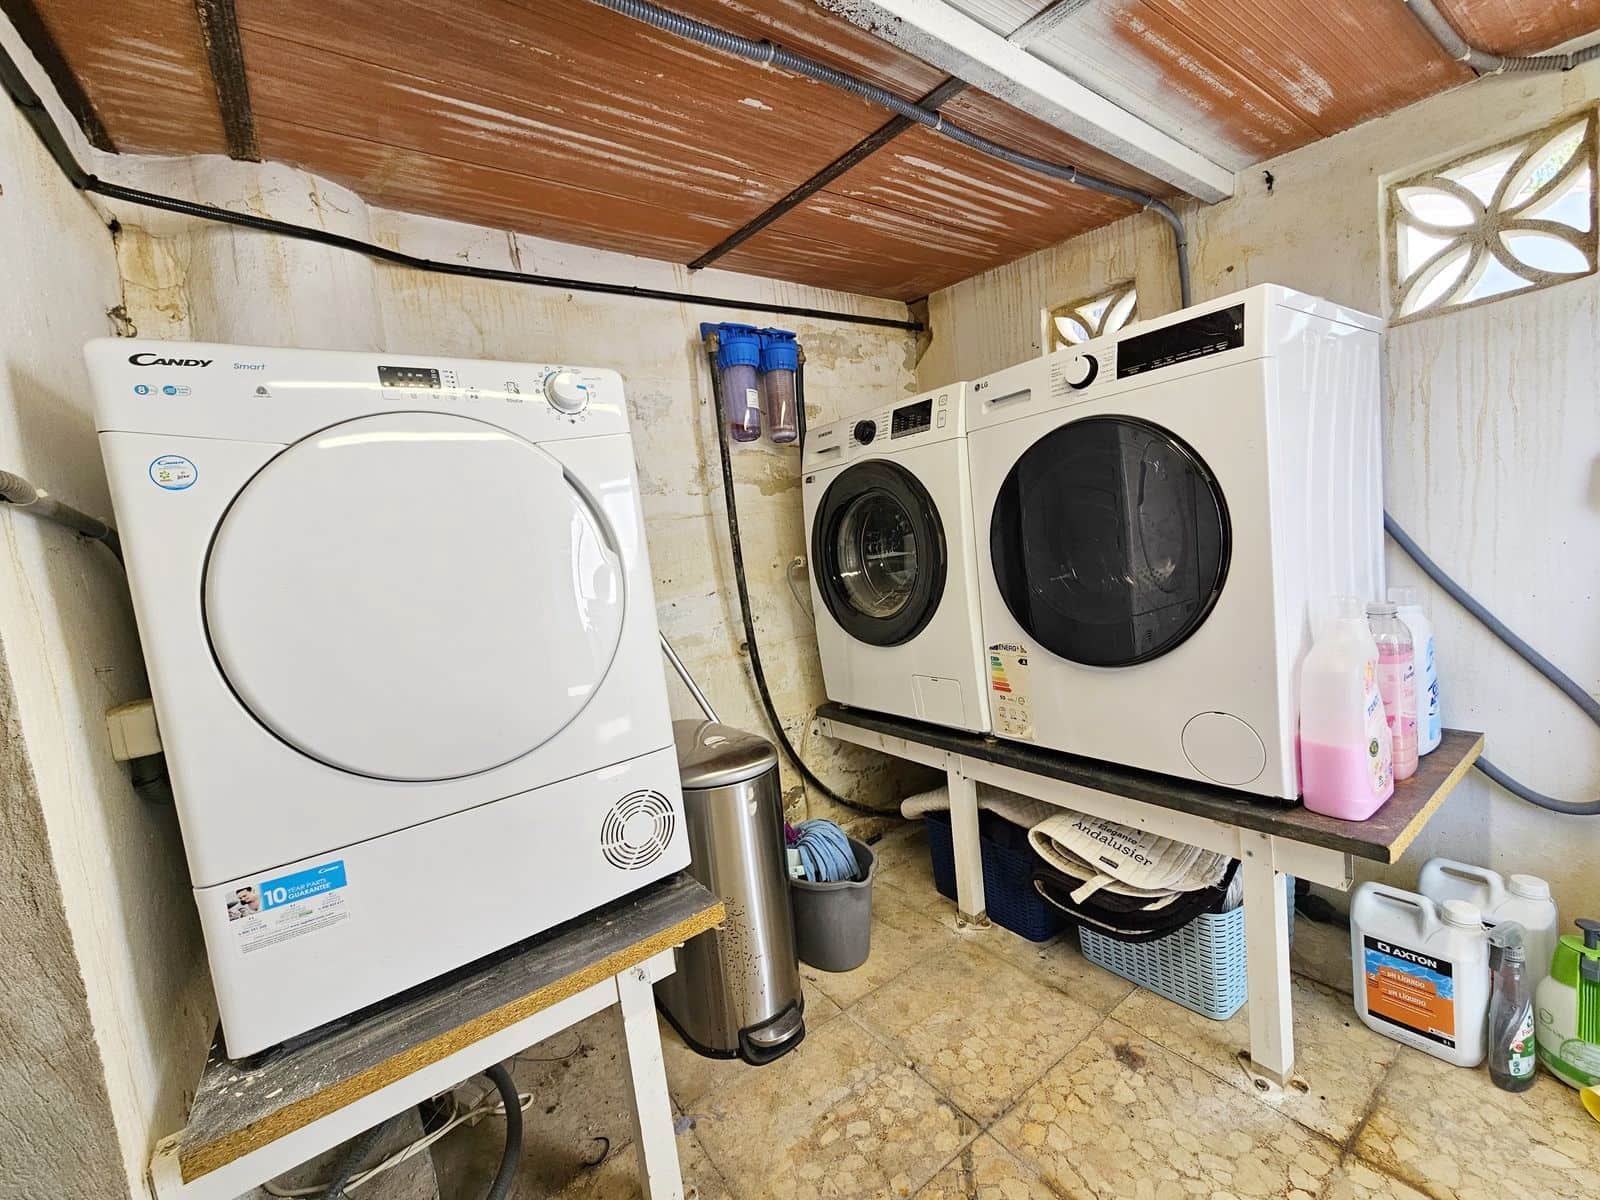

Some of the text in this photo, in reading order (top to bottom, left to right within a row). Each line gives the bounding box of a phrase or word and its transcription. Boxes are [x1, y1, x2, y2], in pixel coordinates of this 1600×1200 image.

[128, 353, 214, 368] CANDY
[233, 362, 266, 371] Smart
[980, 380, 989, 389] LG
[1097, 823, 1139, 846] Elegante
[1072, 822, 1153, 866] Andalusier
[264, 887, 287, 906] 10
[287, 884, 305, 894] YEAR
[287, 882, 331, 900] GUARANTEE
[1393, 949, 1437, 968] AXTON
